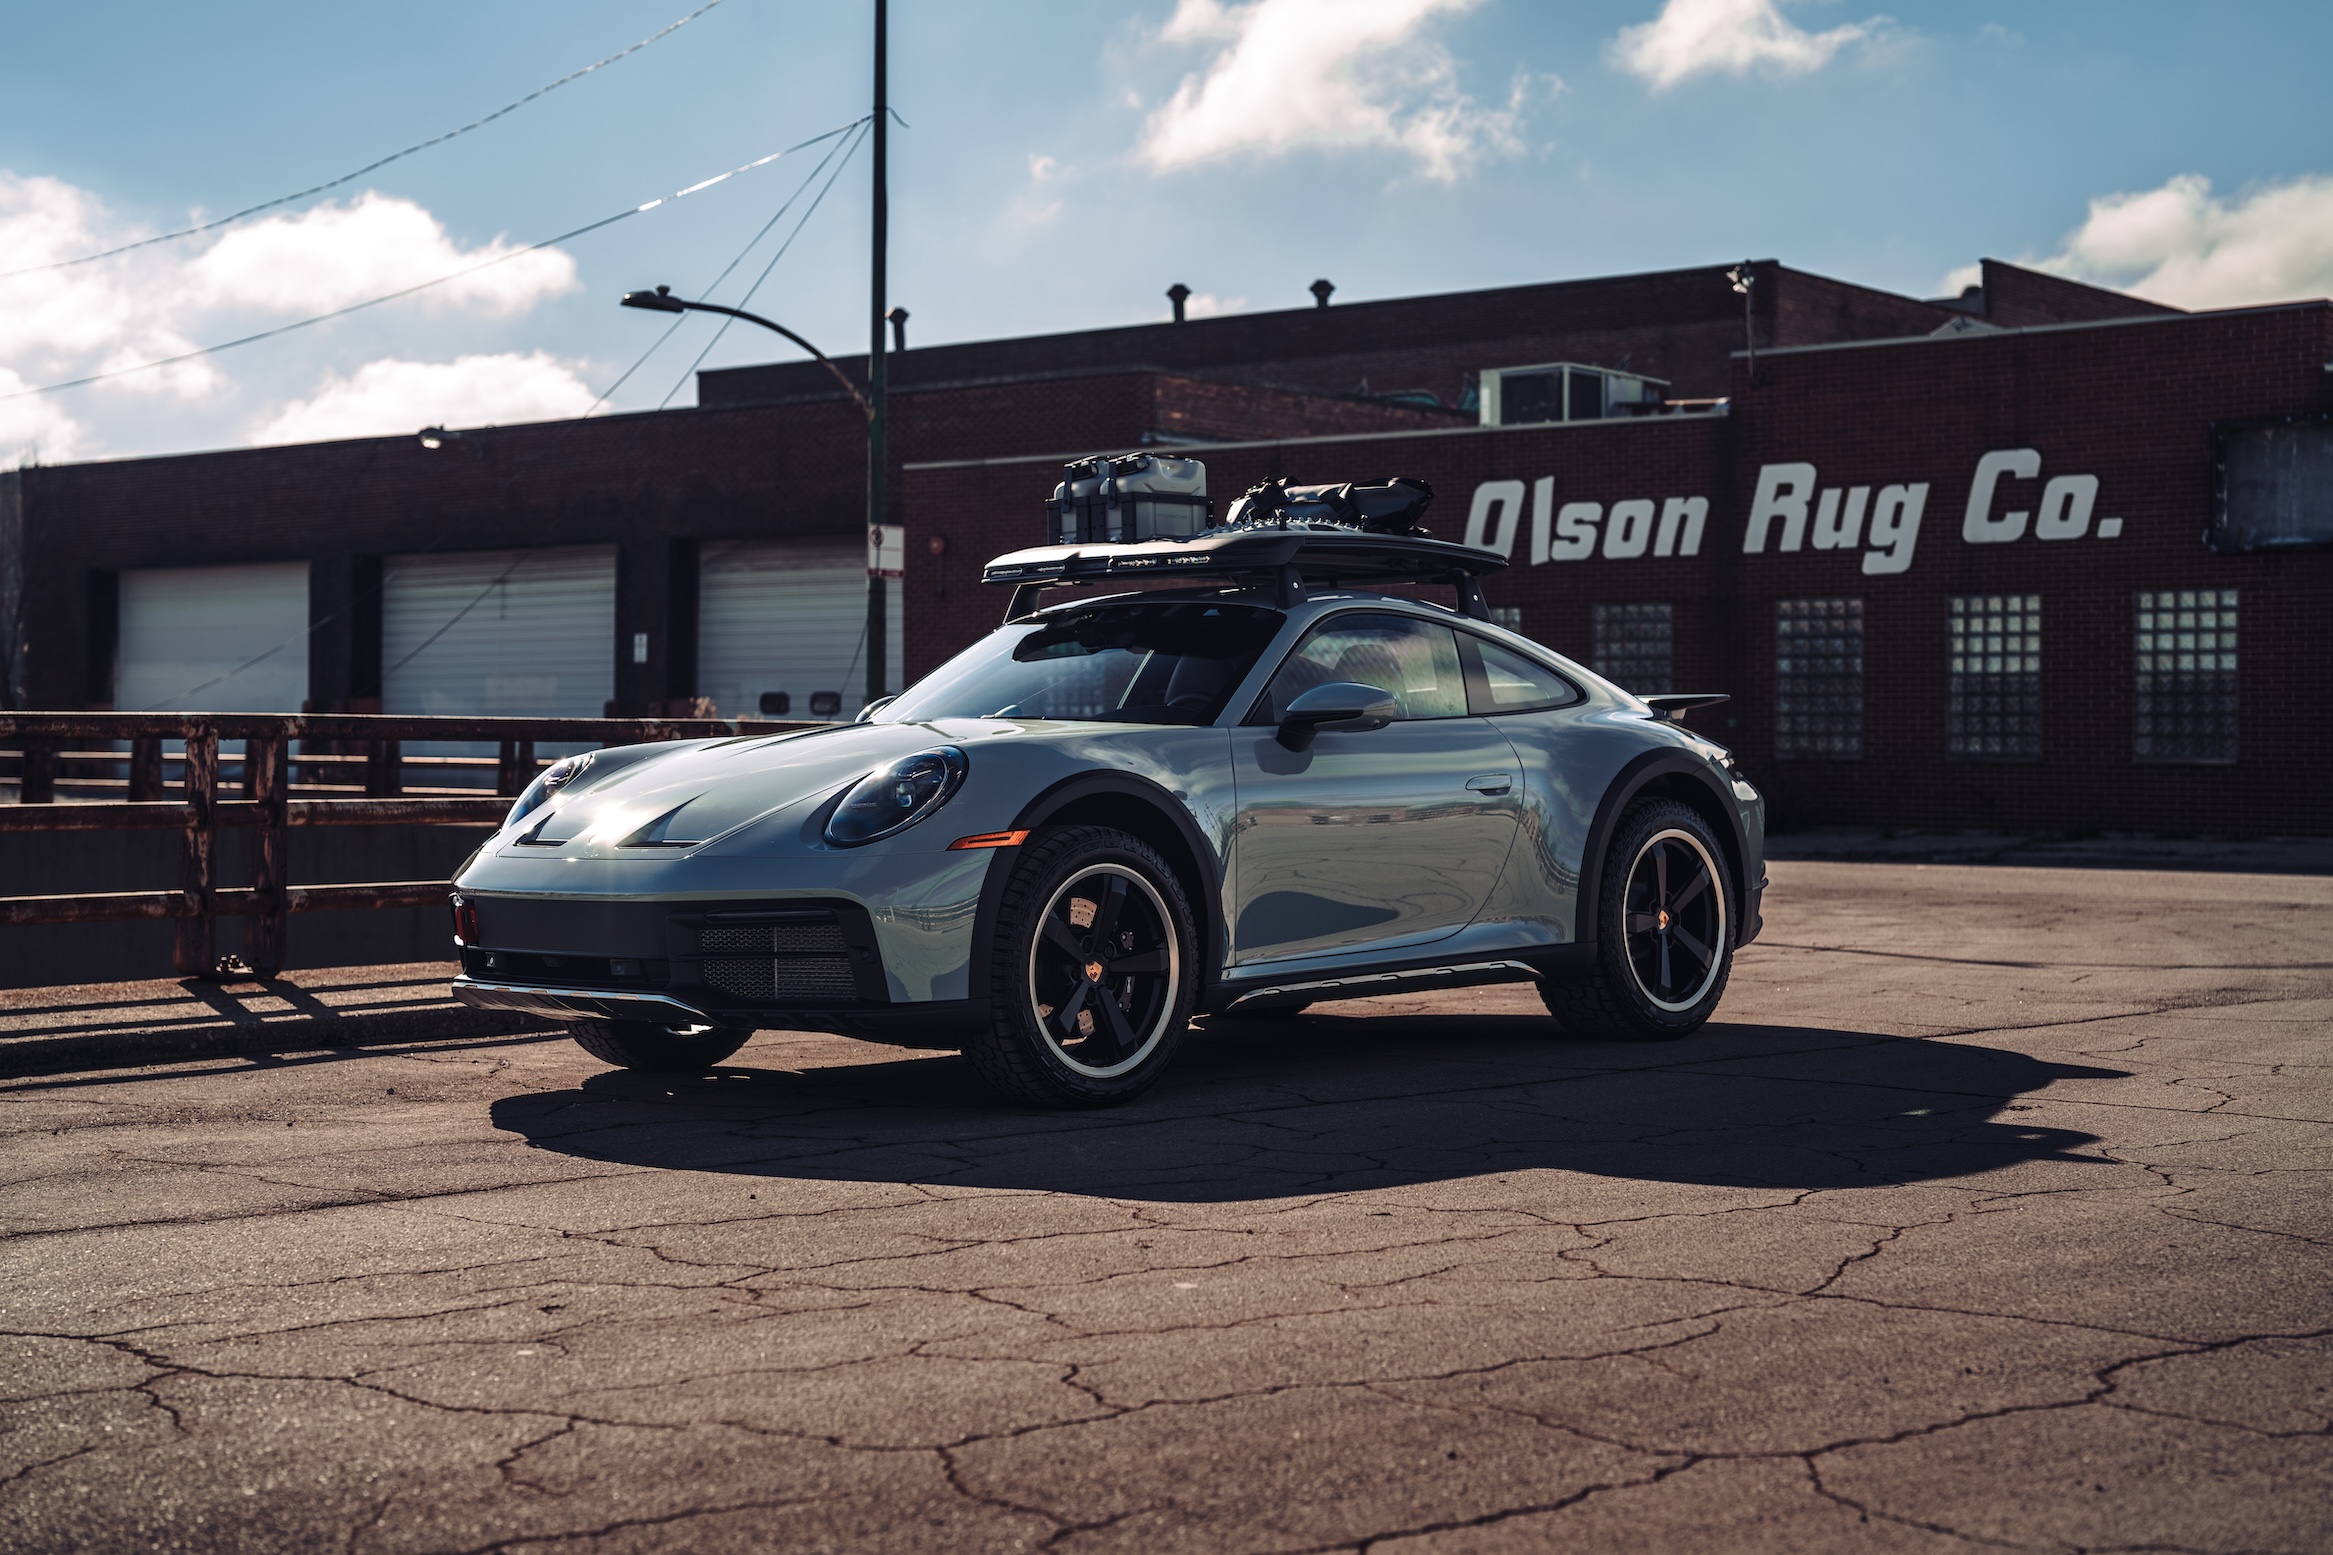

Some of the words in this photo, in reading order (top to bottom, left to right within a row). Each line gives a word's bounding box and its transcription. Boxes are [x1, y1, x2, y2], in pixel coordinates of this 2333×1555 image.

[1463, 476, 1710, 566] Olson
[1742, 462, 1930, 575] Rug
[1962, 448, 2124, 543] Co.
